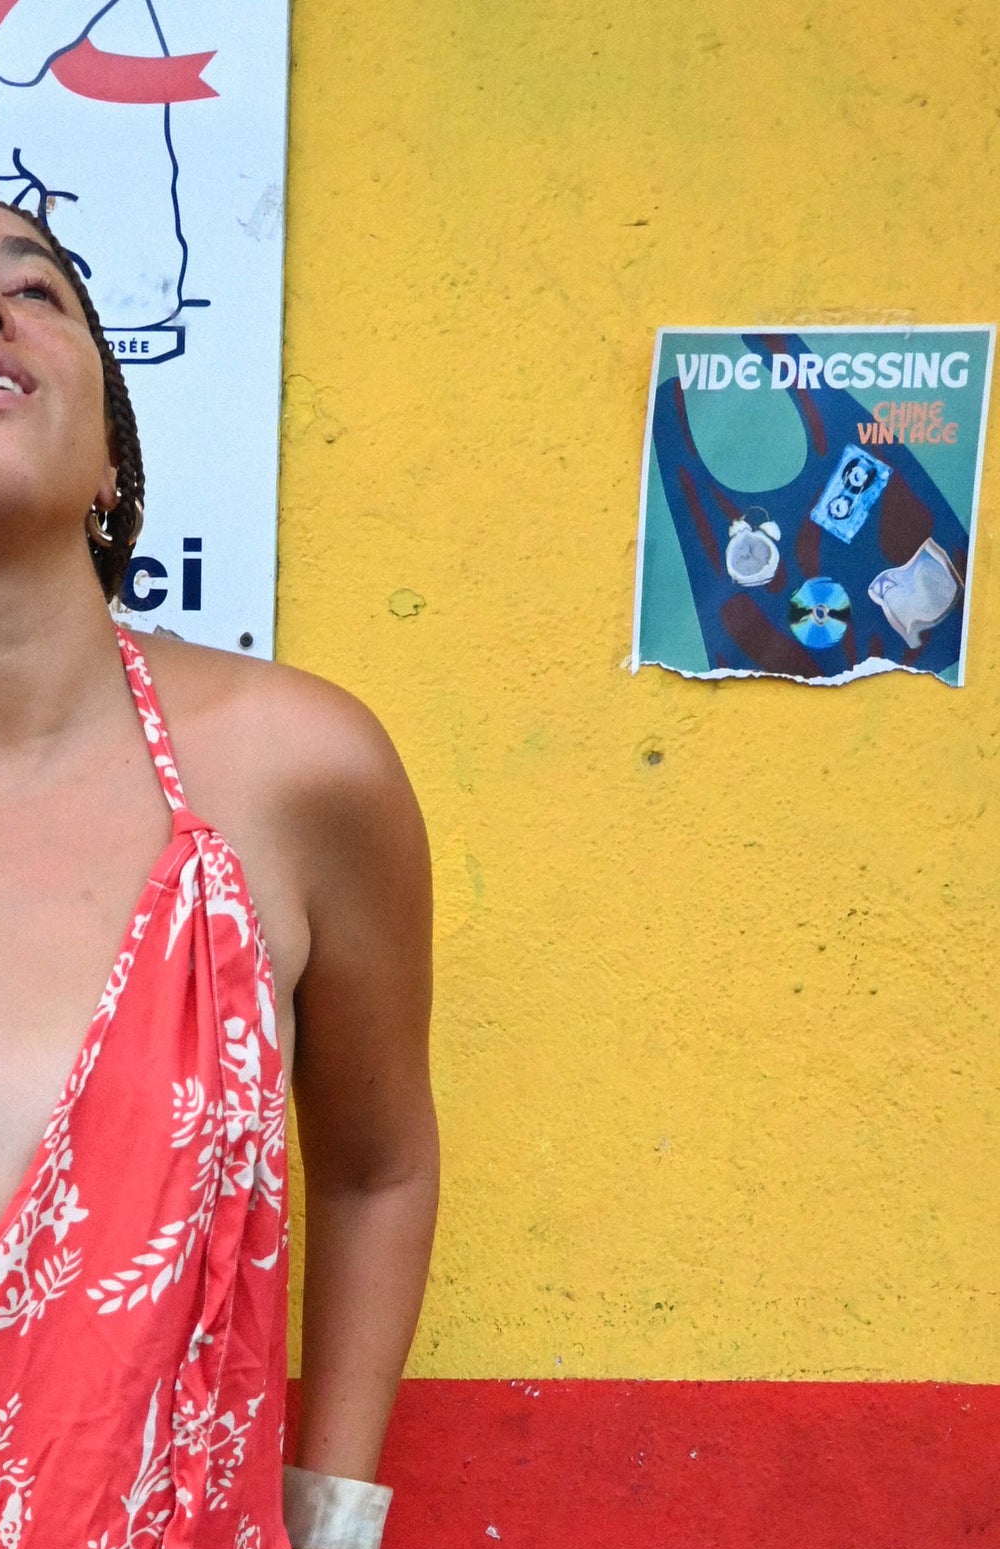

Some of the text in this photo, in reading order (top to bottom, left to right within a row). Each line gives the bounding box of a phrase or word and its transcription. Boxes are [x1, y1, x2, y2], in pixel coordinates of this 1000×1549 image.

[107, 337, 149, 353] OSÉE
[676, 352, 970, 390] VIDE DRESSING
[857, 419, 958, 445] VINTAGE
[122, 537, 202, 612] ci
